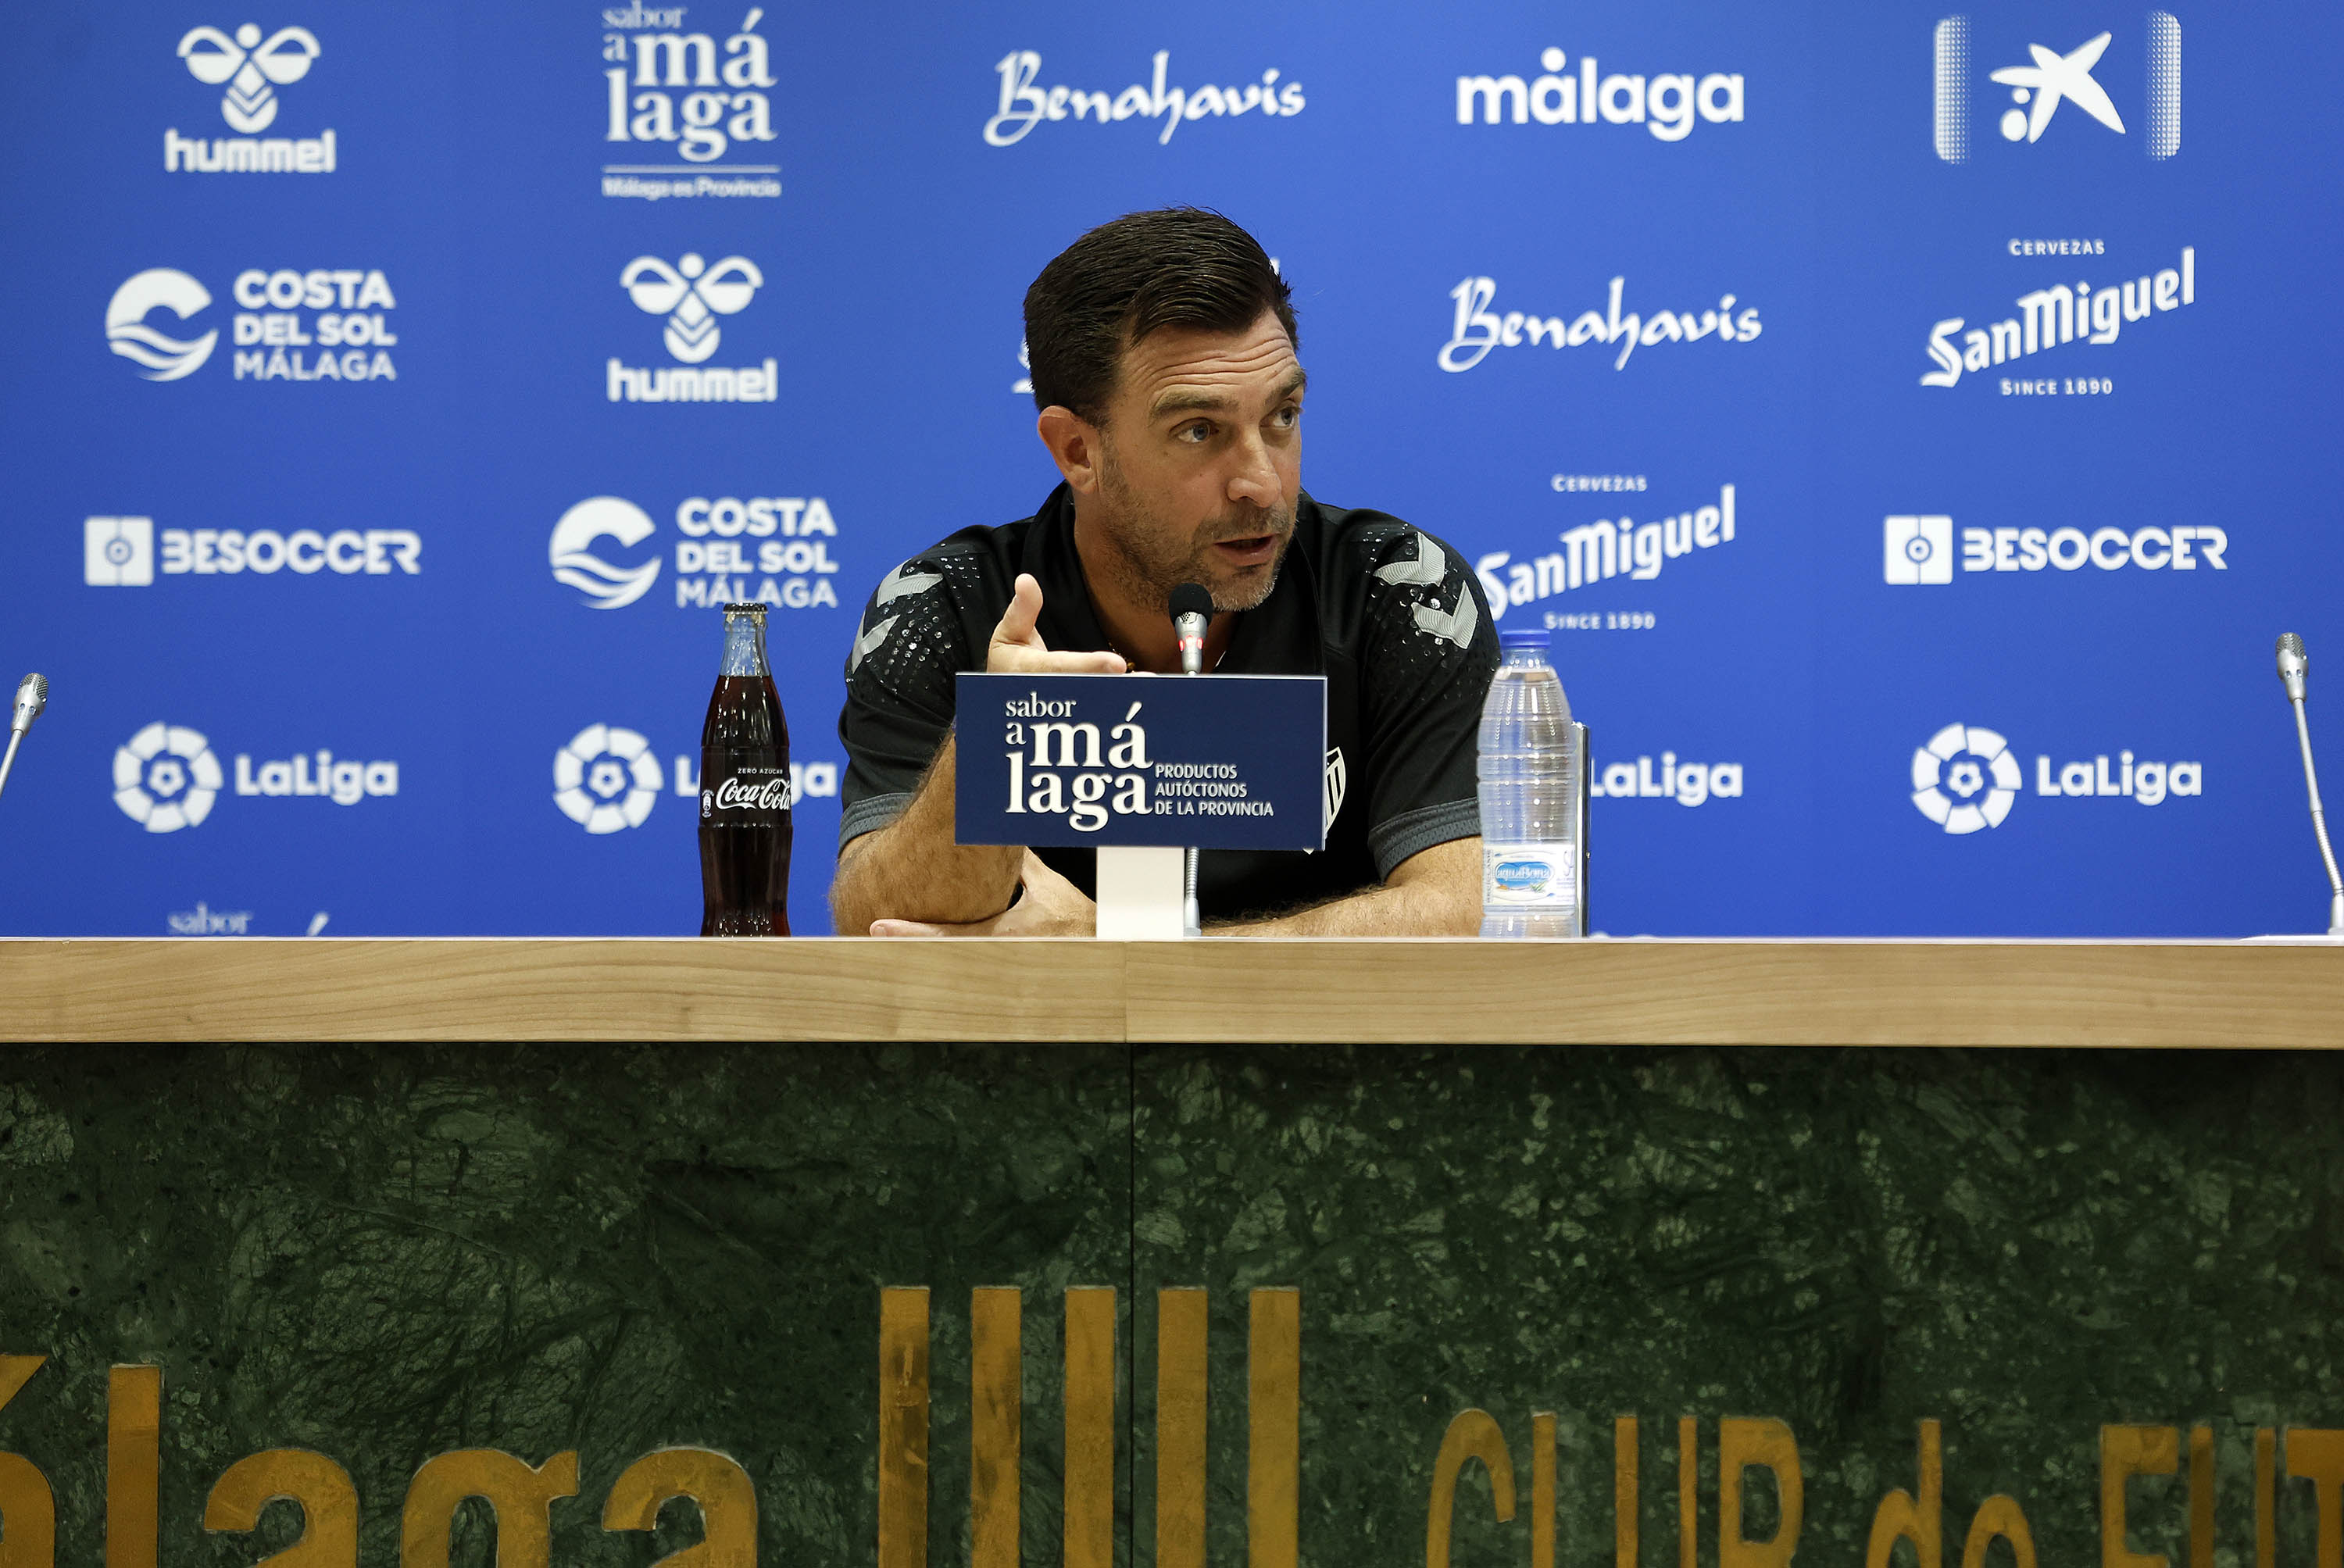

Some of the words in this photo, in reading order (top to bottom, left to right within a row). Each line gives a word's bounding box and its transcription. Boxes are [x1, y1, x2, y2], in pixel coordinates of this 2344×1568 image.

[164, 127, 337, 173] hummel
[2007, 238, 2106, 256] CERVEZAS
[234, 269, 395, 310] COSTA
[234, 314, 312, 346] DEL
[316, 314, 398, 346] SOL
[234, 347, 397, 381] MÁLAGA
[606, 356, 778, 403] hummel
[2065, 378, 2114, 395] 1890
[1550, 474, 1648, 492] CERVEZAS
[676, 497, 838, 538] COSTA
[162, 529, 423, 575] BESOCCER
[676, 541, 754, 574] DEL
[759, 541, 839, 574] SOL
[1962, 526, 2228, 572] BESOCCER
[676, 574, 838, 609] MÁLAGA
[1607, 612, 1656, 630] 1890
[1005, 691, 1077, 717] sabor
[234, 748, 399, 805] LaLiga
[1155, 763, 1238, 780] PRODUCTOS
[2036, 750, 2202, 806] LaLiga
[1155, 780, 1248, 798] AUTÓCTONOS
[1155, 800, 1173, 816] DE
[1177, 800, 1195, 816] LA
[1198, 800, 1274, 817] PROVINCIA
